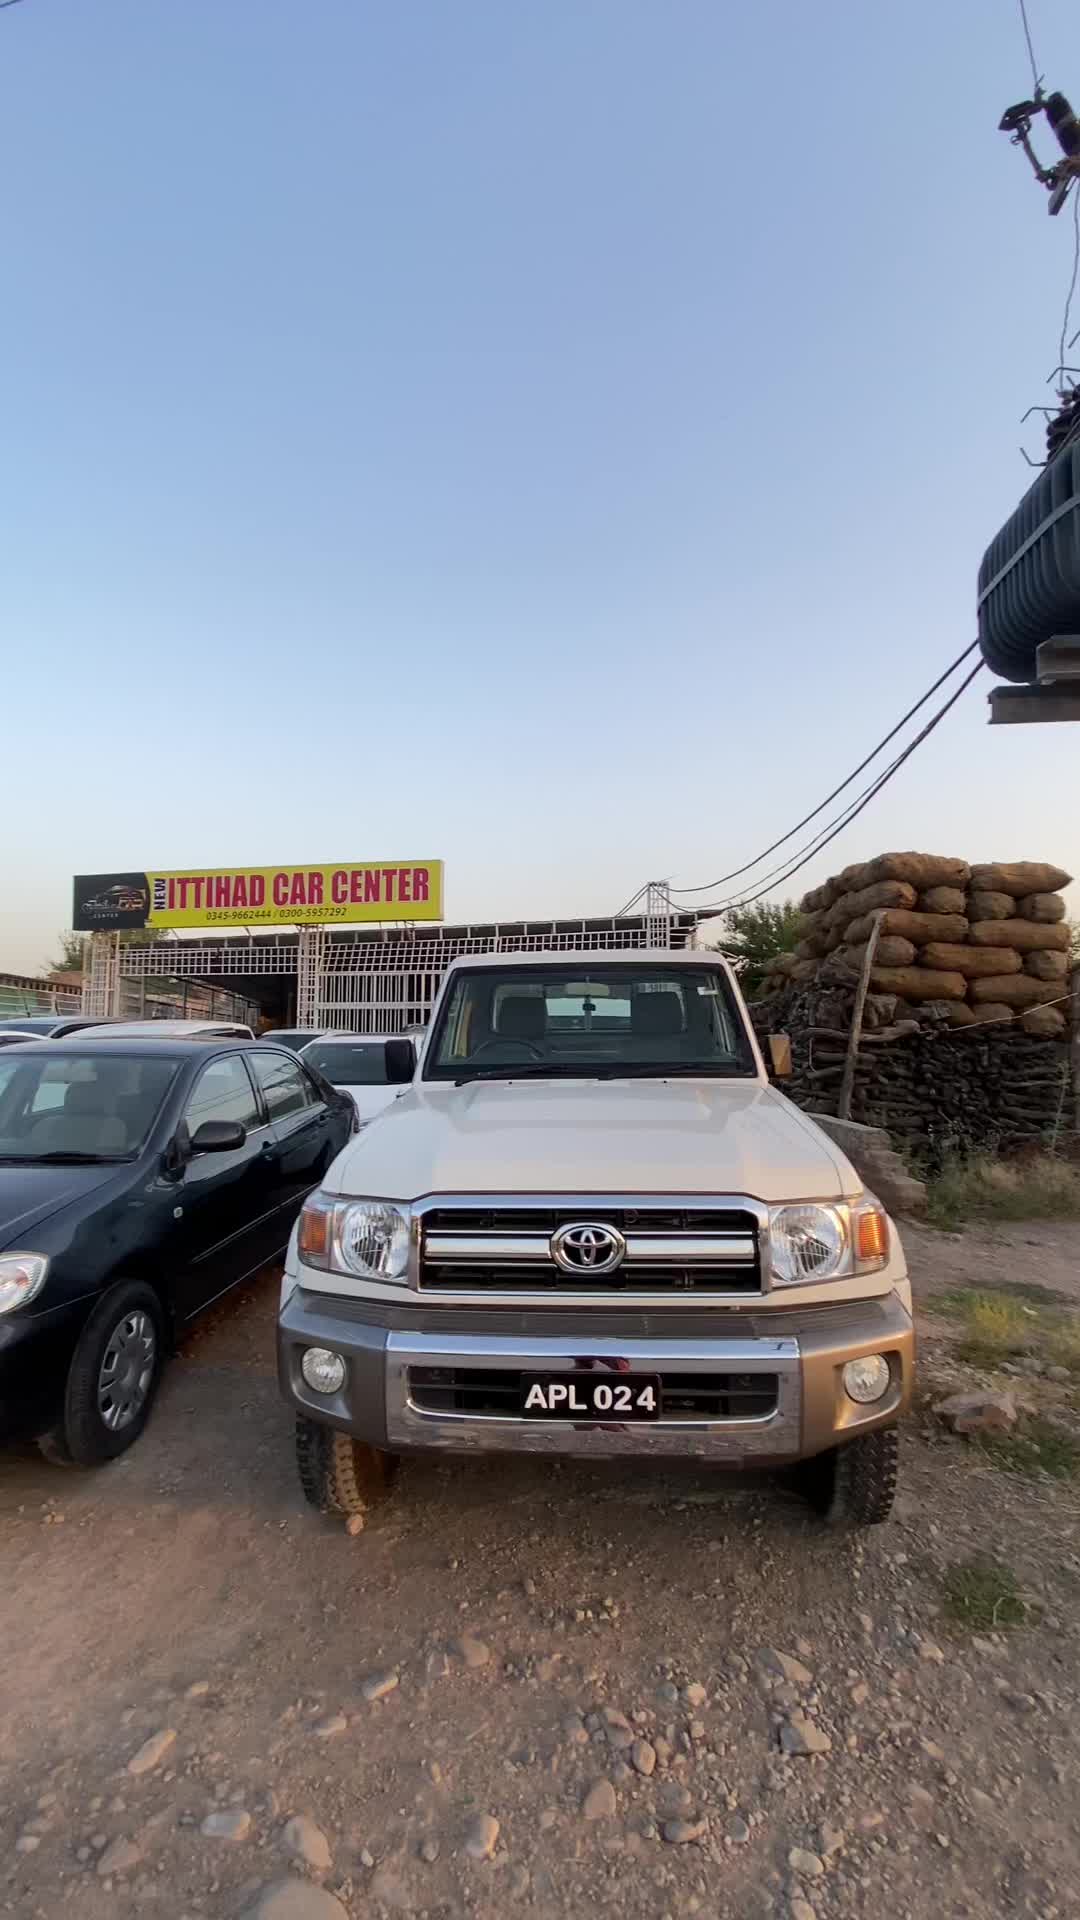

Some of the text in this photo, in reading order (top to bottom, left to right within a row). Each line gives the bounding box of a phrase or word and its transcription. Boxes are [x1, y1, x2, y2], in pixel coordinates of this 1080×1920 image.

[154, 879, 166, 910] NEW
[168, 868, 429, 909] ITTIHAD CAR CENTER
[524, 1384, 657, 1411] APL 024
